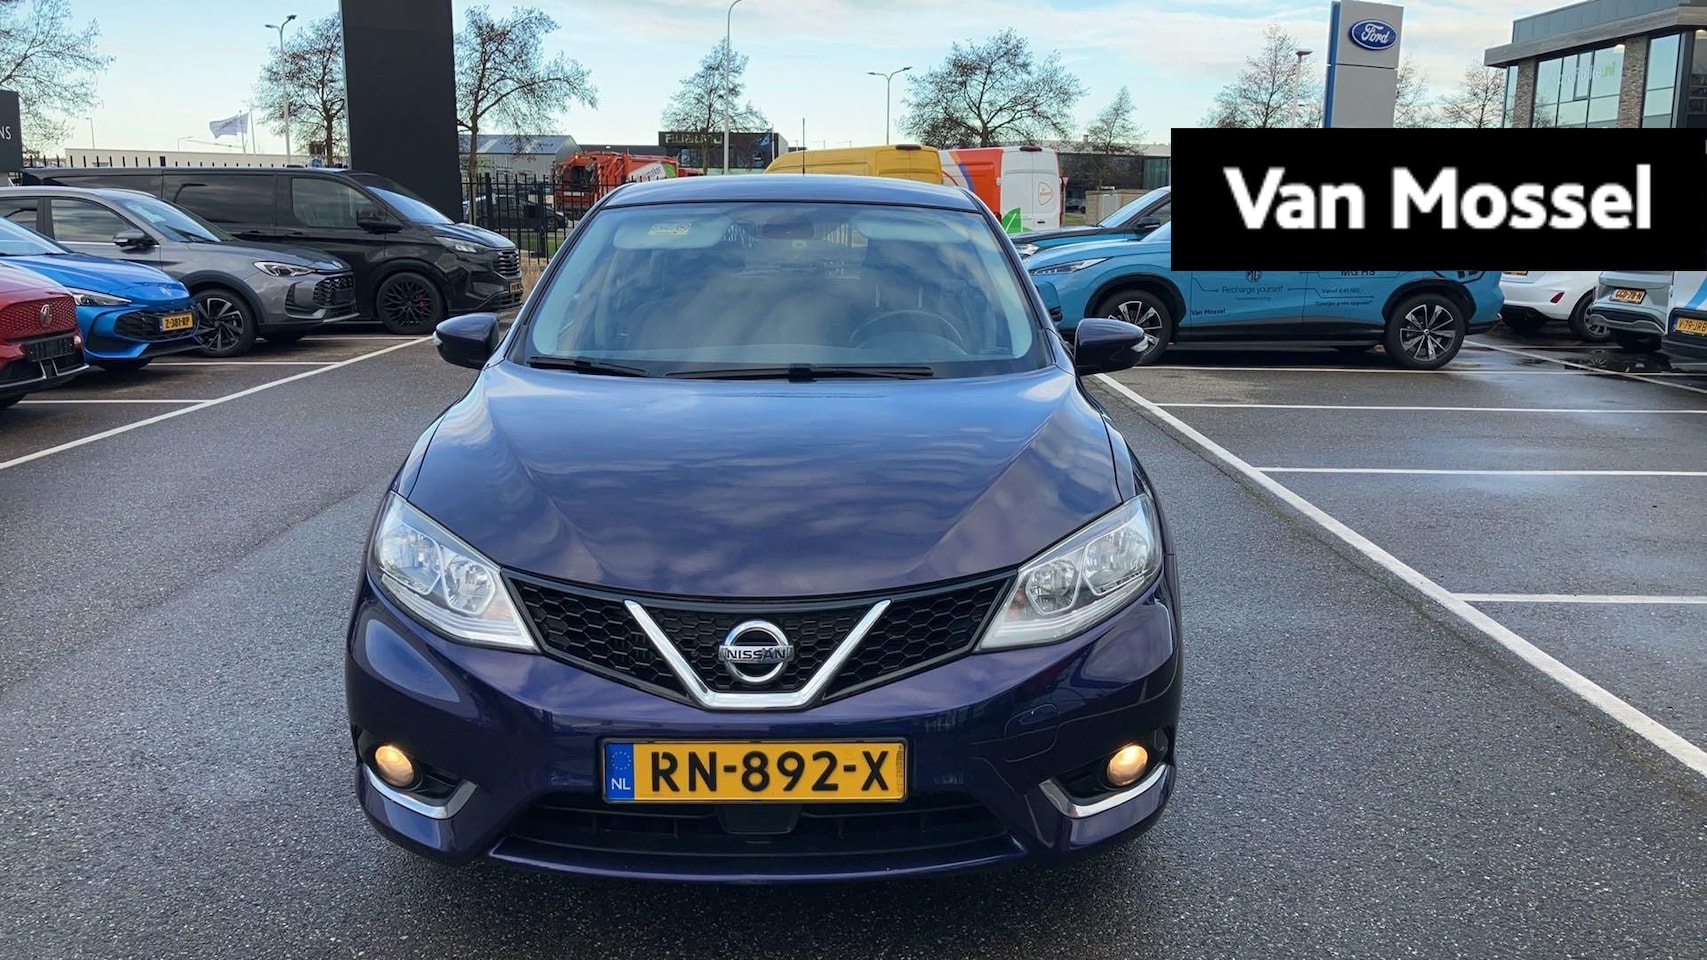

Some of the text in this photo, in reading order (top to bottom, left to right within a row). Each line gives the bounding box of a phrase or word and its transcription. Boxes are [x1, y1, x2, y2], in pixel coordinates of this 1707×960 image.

[1361, 23, 1390, 44] Ford
[1222, 285, 1284, 295] Recharge yourself
[1204, 308, 1226, 316] Mossel
[727, 648, 785, 660] NISSAN
[651, 751, 890, 792] RN-892-X
[611, 778, 631, 791] NL
